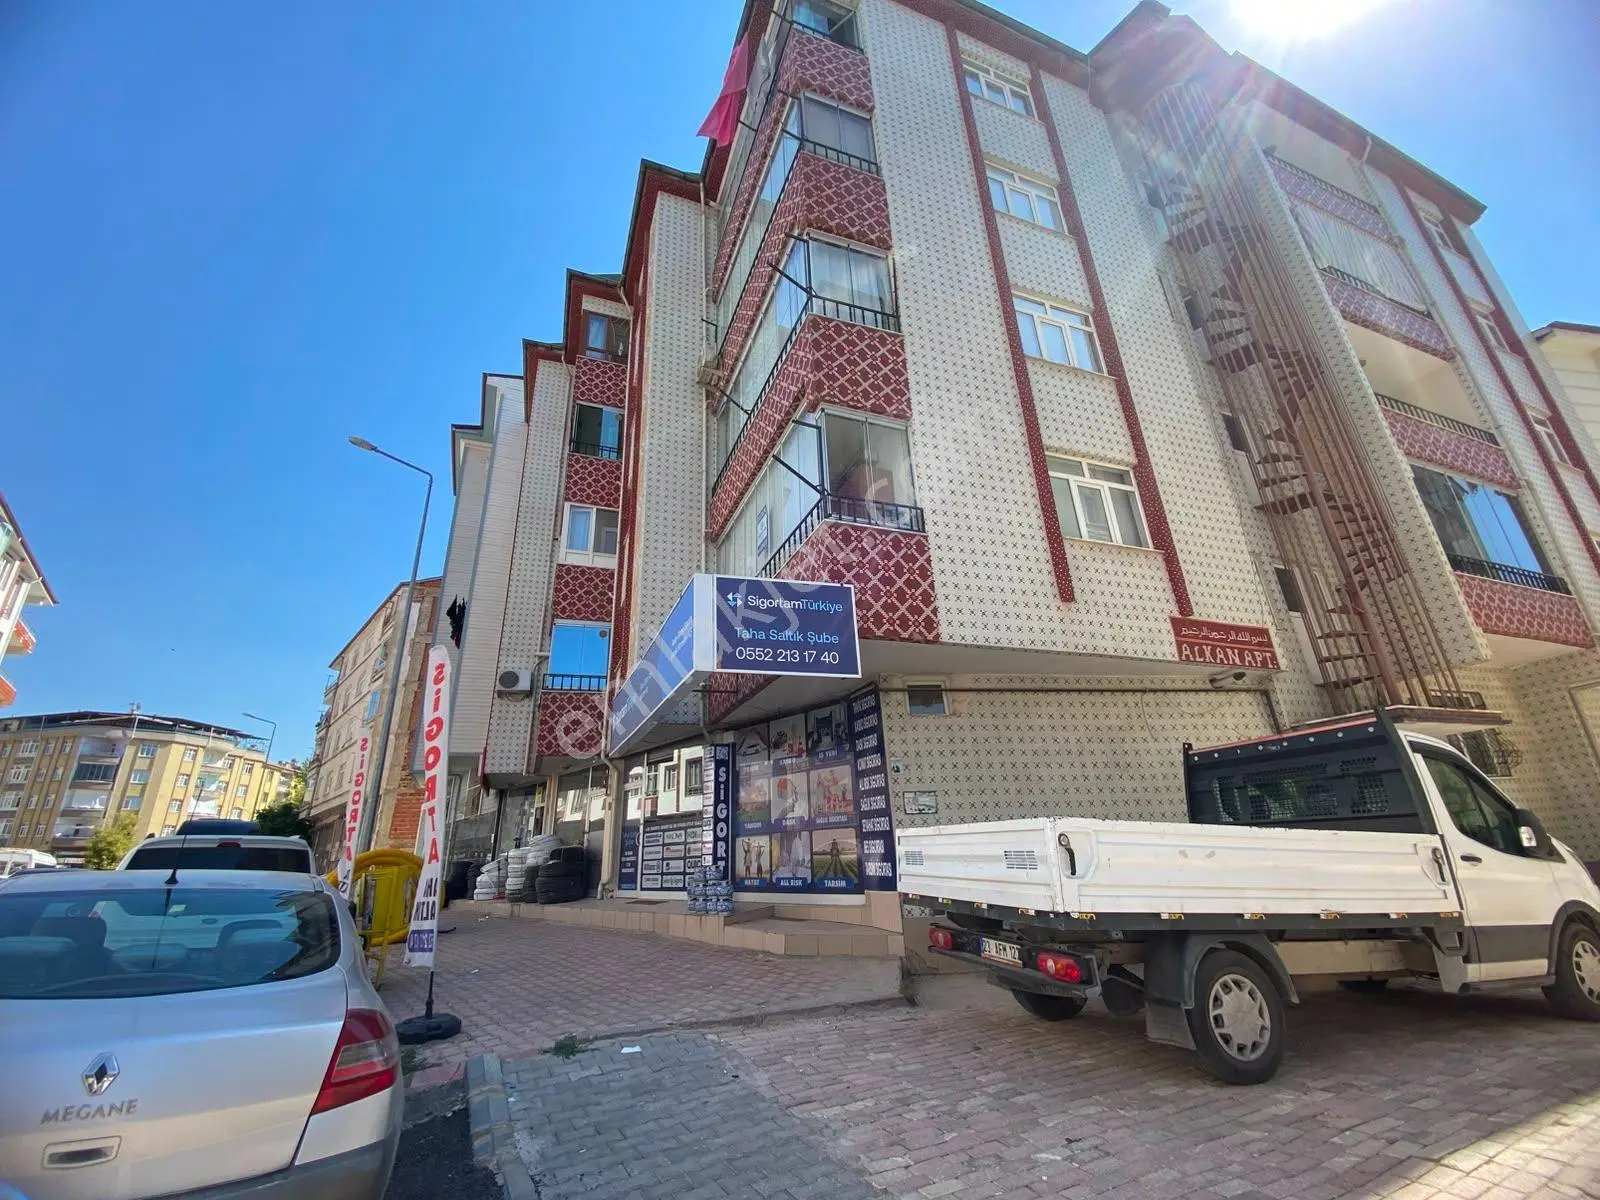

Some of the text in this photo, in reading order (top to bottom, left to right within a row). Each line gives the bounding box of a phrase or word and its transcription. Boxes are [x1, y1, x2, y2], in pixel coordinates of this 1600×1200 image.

[747, 595, 843, 613] SigortamTürkiye
[734, 626, 766, 639] Taha
[807, 631, 839, 645] Şube
[735, 646, 839, 664] 0552 213 17 40
[1181, 643, 1242, 666] ALKAN
[40, 1098, 140, 1125] MEGANE
